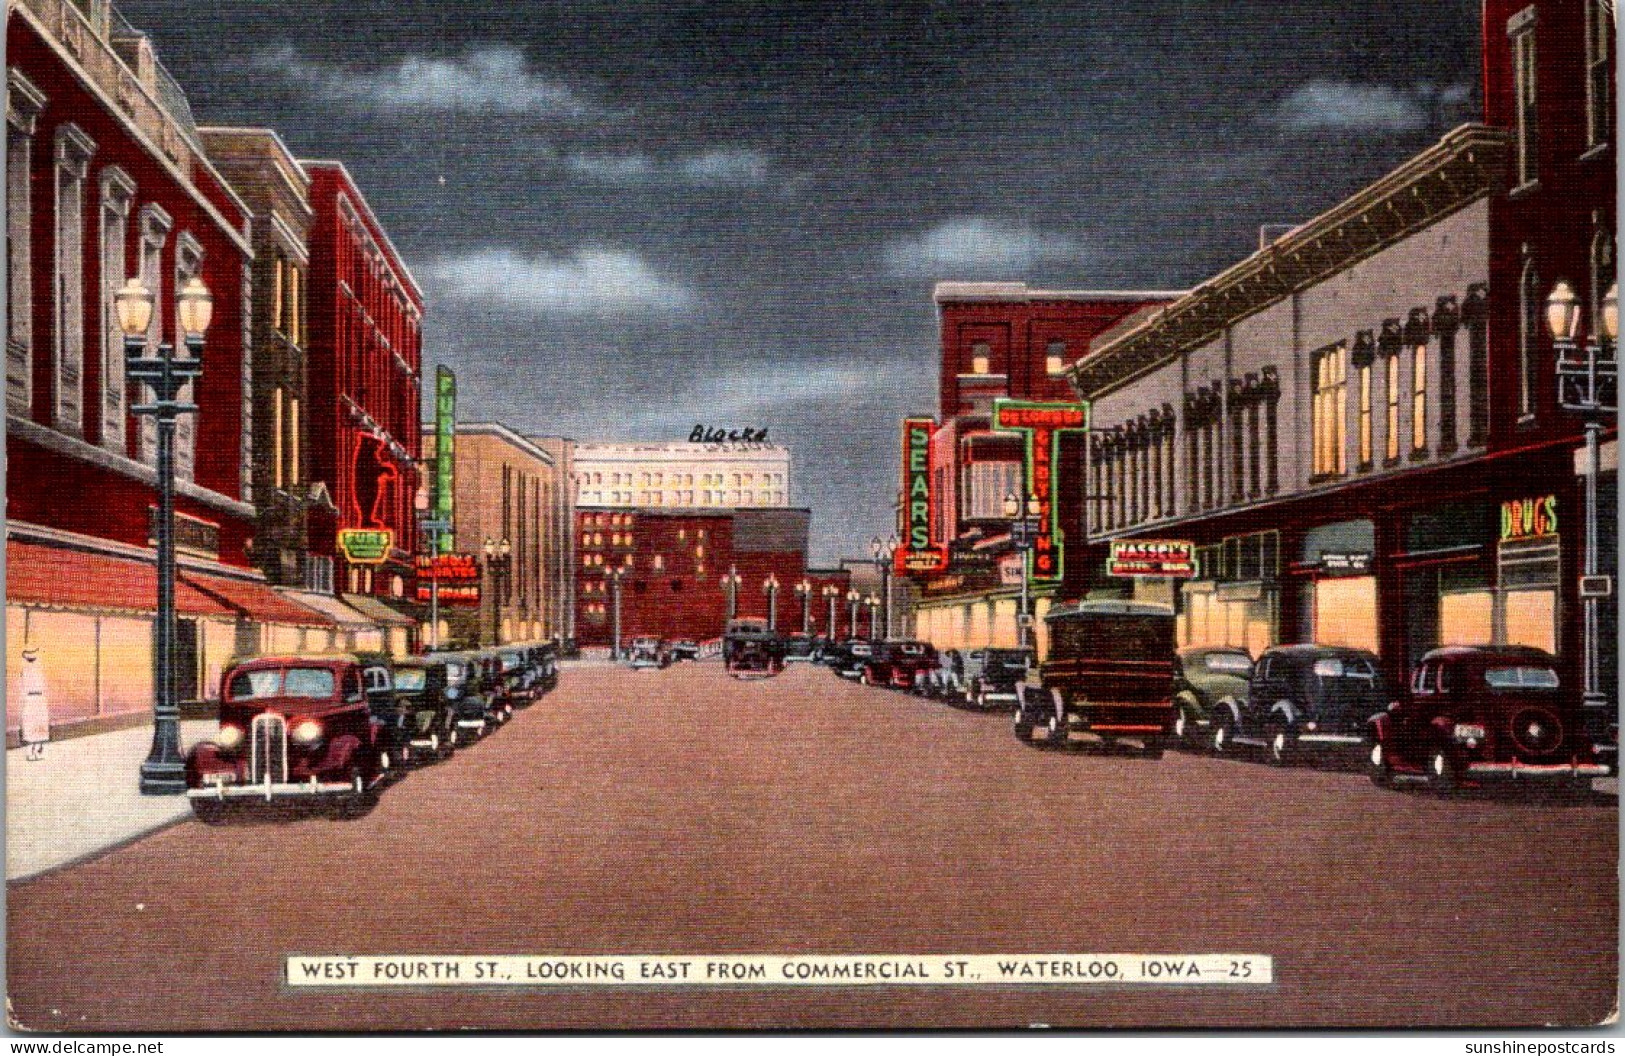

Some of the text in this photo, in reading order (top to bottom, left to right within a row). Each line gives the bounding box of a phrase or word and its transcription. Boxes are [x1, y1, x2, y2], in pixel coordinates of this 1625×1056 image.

[910, 427, 929, 550] SEARS
[1034, 429, 1051, 571] CLOTHING
[1501, 495, 1557, 539] DRUGS
